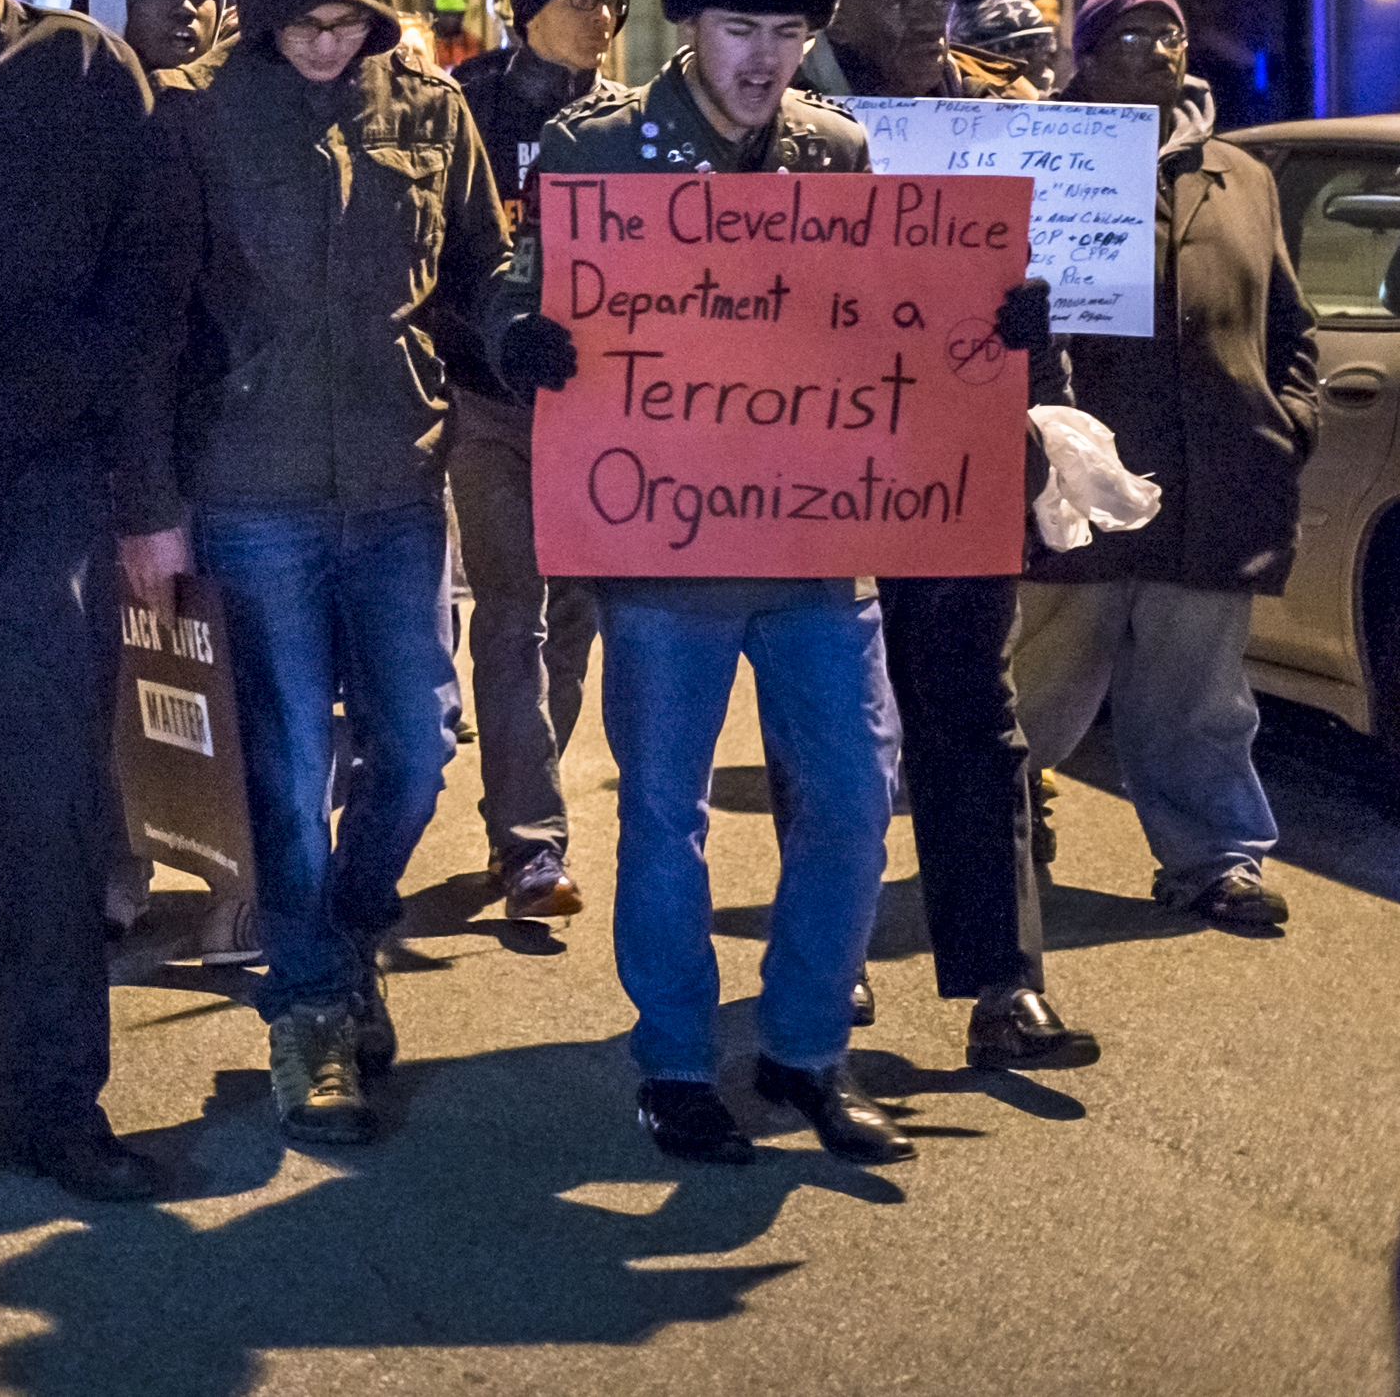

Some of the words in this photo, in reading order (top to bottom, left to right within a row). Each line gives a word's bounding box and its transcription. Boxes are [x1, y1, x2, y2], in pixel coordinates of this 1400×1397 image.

[865, 111, 908, 141] AR
[950, 115, 985, 139] OF
[550, 178, 645, 243] The
[668, 179, 877, 247] Cleveland
[894, 182, 1009, 250] Police
[570, 259, 791, 334] Department
[831, 292, 860, 330] is
[893, 301, 925, 329] a
[603, 350, 917, 434] Terrorist
[588, 447, 970, 550] Organization!
[172, 616, 214, 666] LIVES
[144, 689, 204, 745] MATTER
